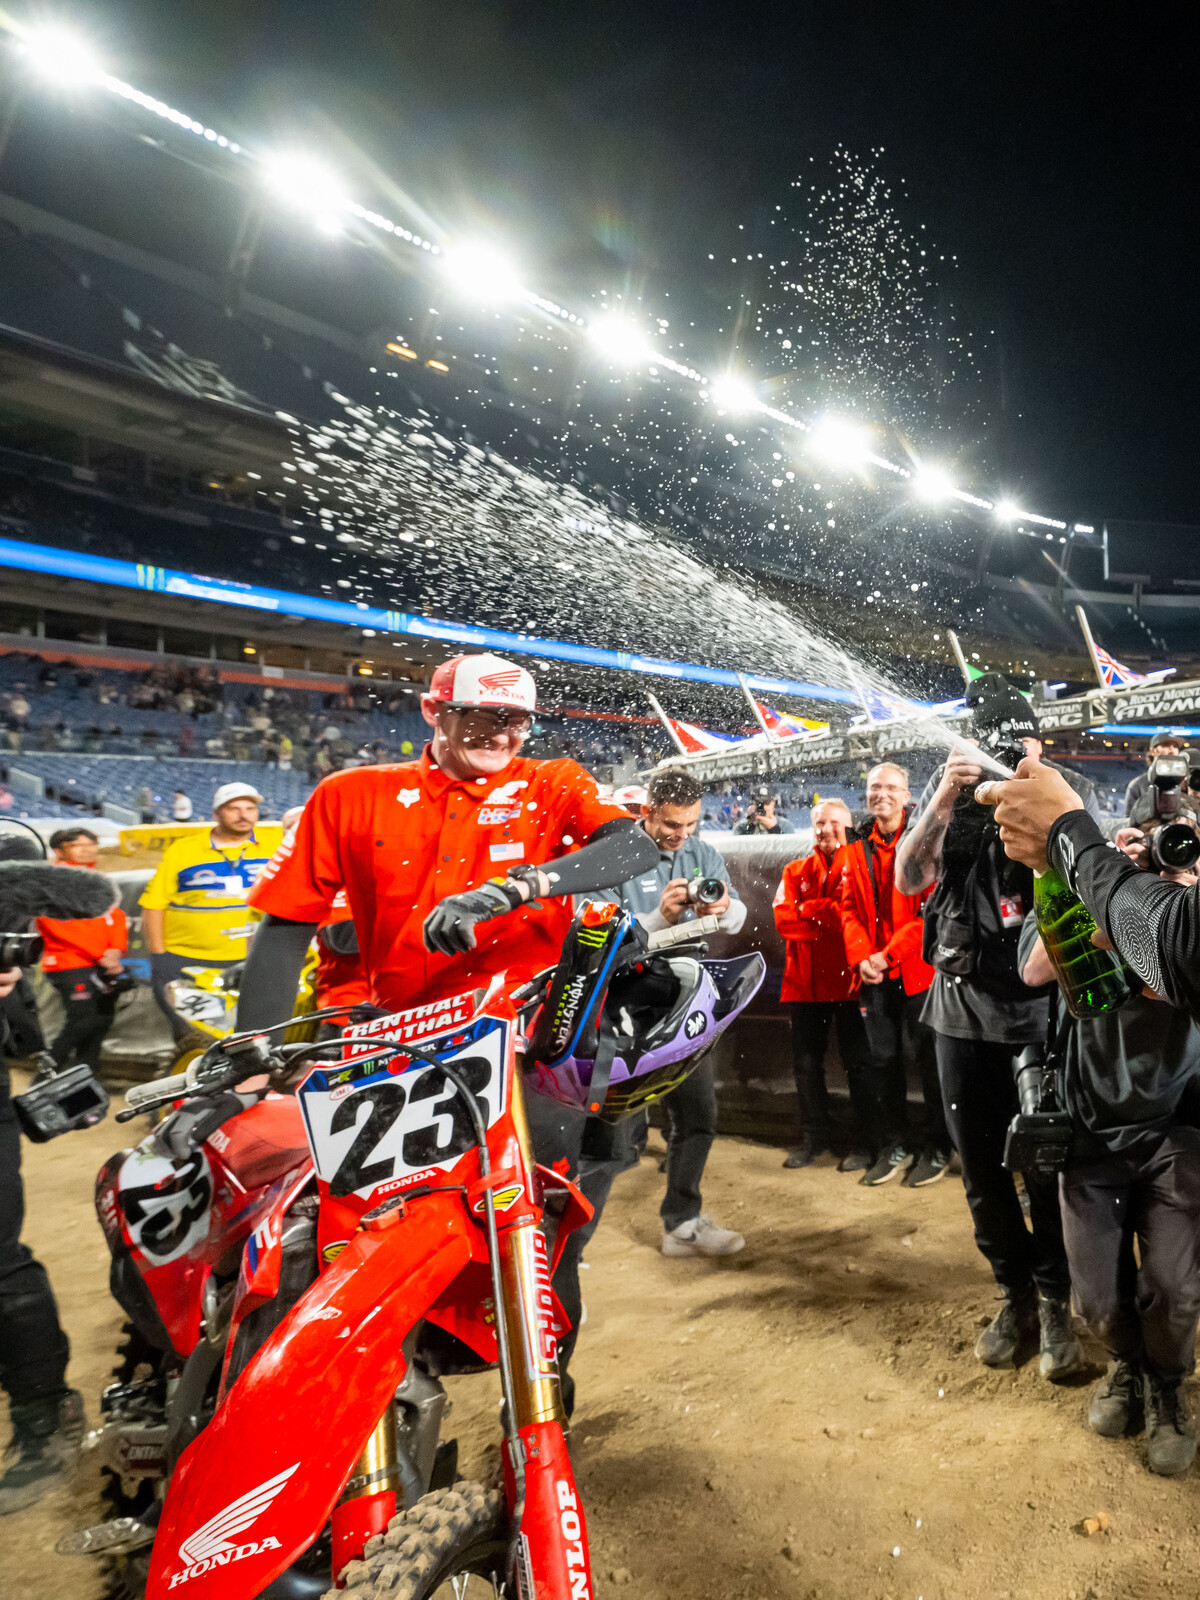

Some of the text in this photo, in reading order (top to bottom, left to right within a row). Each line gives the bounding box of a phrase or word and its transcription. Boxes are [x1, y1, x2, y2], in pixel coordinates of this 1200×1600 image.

[1129, 692, 1162, 706] ROCKY
[350, 993, 468, 1040] RENTHAL
[551, 984, 572, 1034] ENERGY
[555, 974, 588, 1049] MONSTER
[328, 1054, 494, 1199] 23
[377, 1169, 437, 1196] HONDA
[167, 1535, 283, 1591] HONDA
